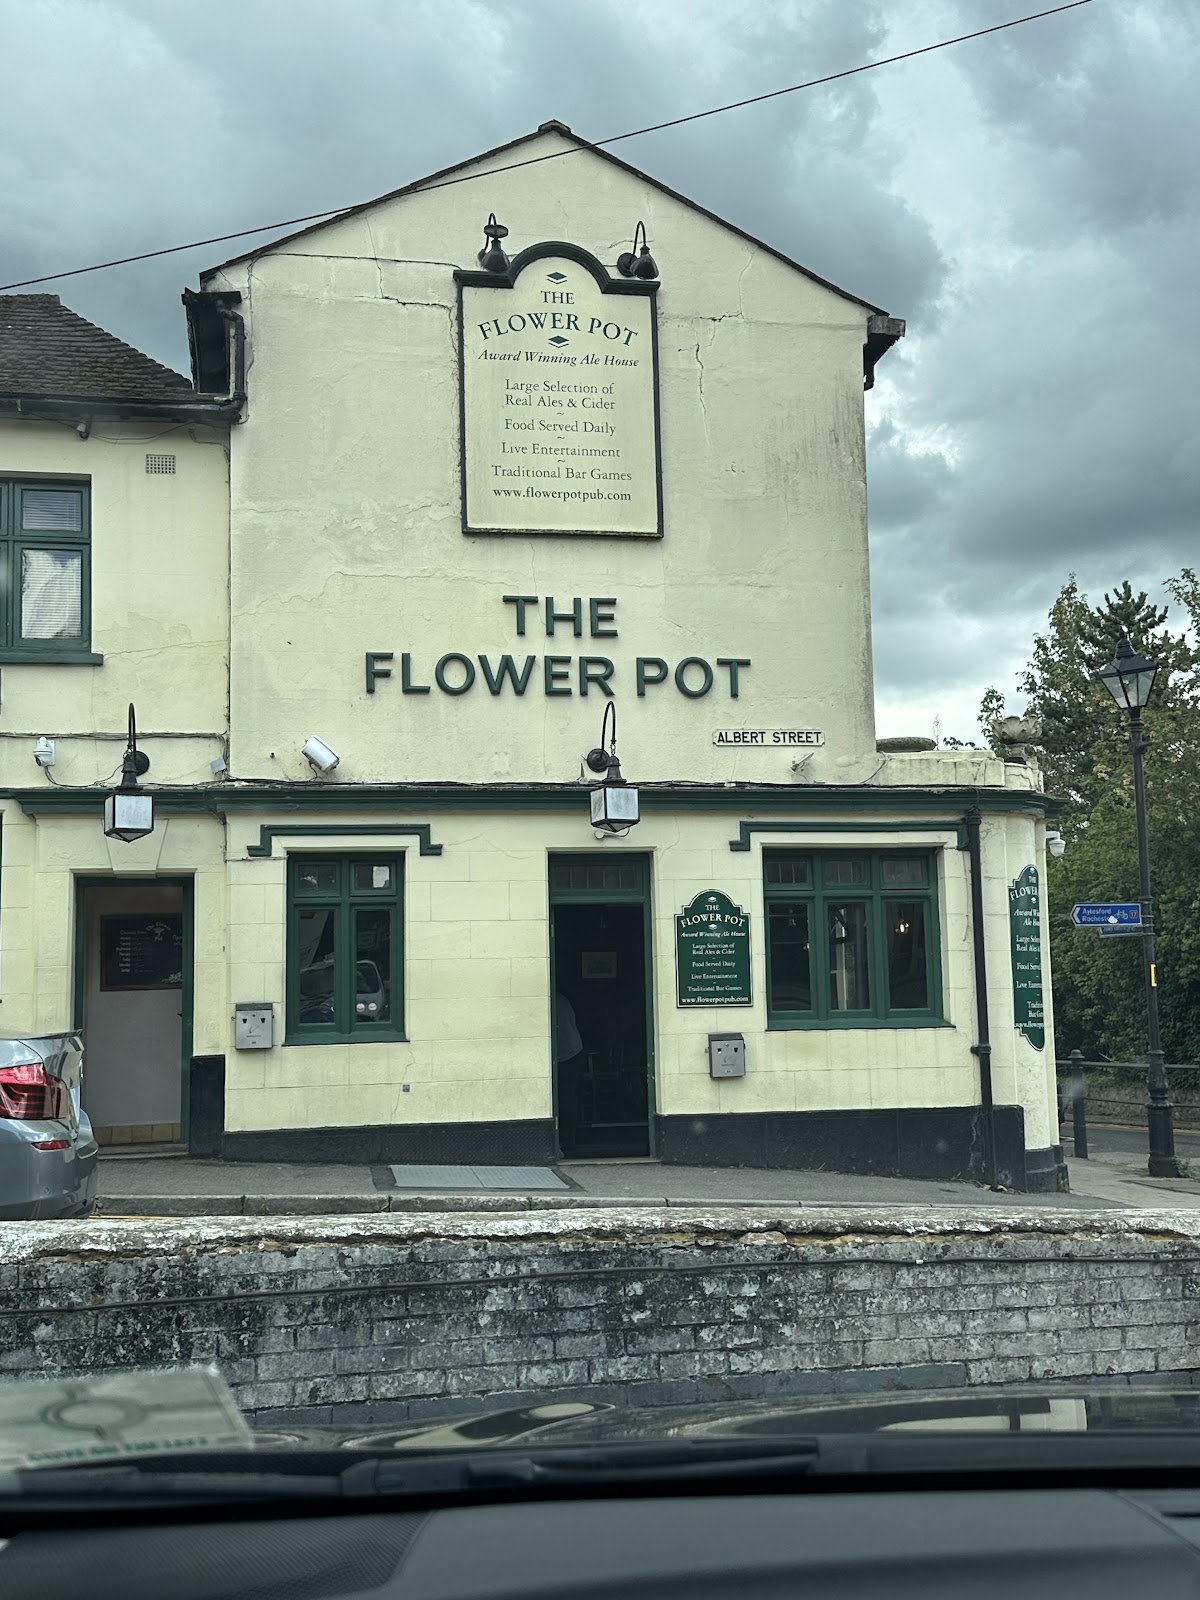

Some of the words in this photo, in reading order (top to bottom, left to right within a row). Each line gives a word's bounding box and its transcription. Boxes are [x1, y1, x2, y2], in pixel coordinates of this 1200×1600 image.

[540, 290, 575, 305] THE
[477, 312, 580, 341] FLOWER
[588, 317, 638, 346] POT
[478, 349, 521, 361] Award
[525, 351, 577, 366] Winning
[580, 355, 600, 365] Ale
[604, 356, 639, 367] House
[505, 379, 540, 394] Large
[543, 381, 598, 394] Selection
[602, 383, 615, 394] of
[505, 395, 532, 406] Real
[537, 396, 563, 408] Ales
[567, 399, 577, 408] &
[581, 398, 616, 410] Cider
[504, 419, 535, 431] Food
[539, 421, 578, 432] Served
[583, 422, 616, 436] Daily
[501, 443, 528, 454] Live
[532, 444, 620, 457] Entertainment
[491, 465, 561, 478] Traditional
[565, 468, 586, 479] Bar
[590, 469, 632, 481] Games
[493, 488, 631, 501] www.flowerpotpub.com
[502, 595, 618, 637] THE
[365, 652, 615, 696] FLOWER
[636, 657, 751, 698] POT
[718, 732, 766, 743] ALBERT
[772, 732, 821, 743] STREET
[681, 914, 722, 928] FLOWER
[725, 915, 745, 926] POT
[1016, 935, 1030, 944] Large
